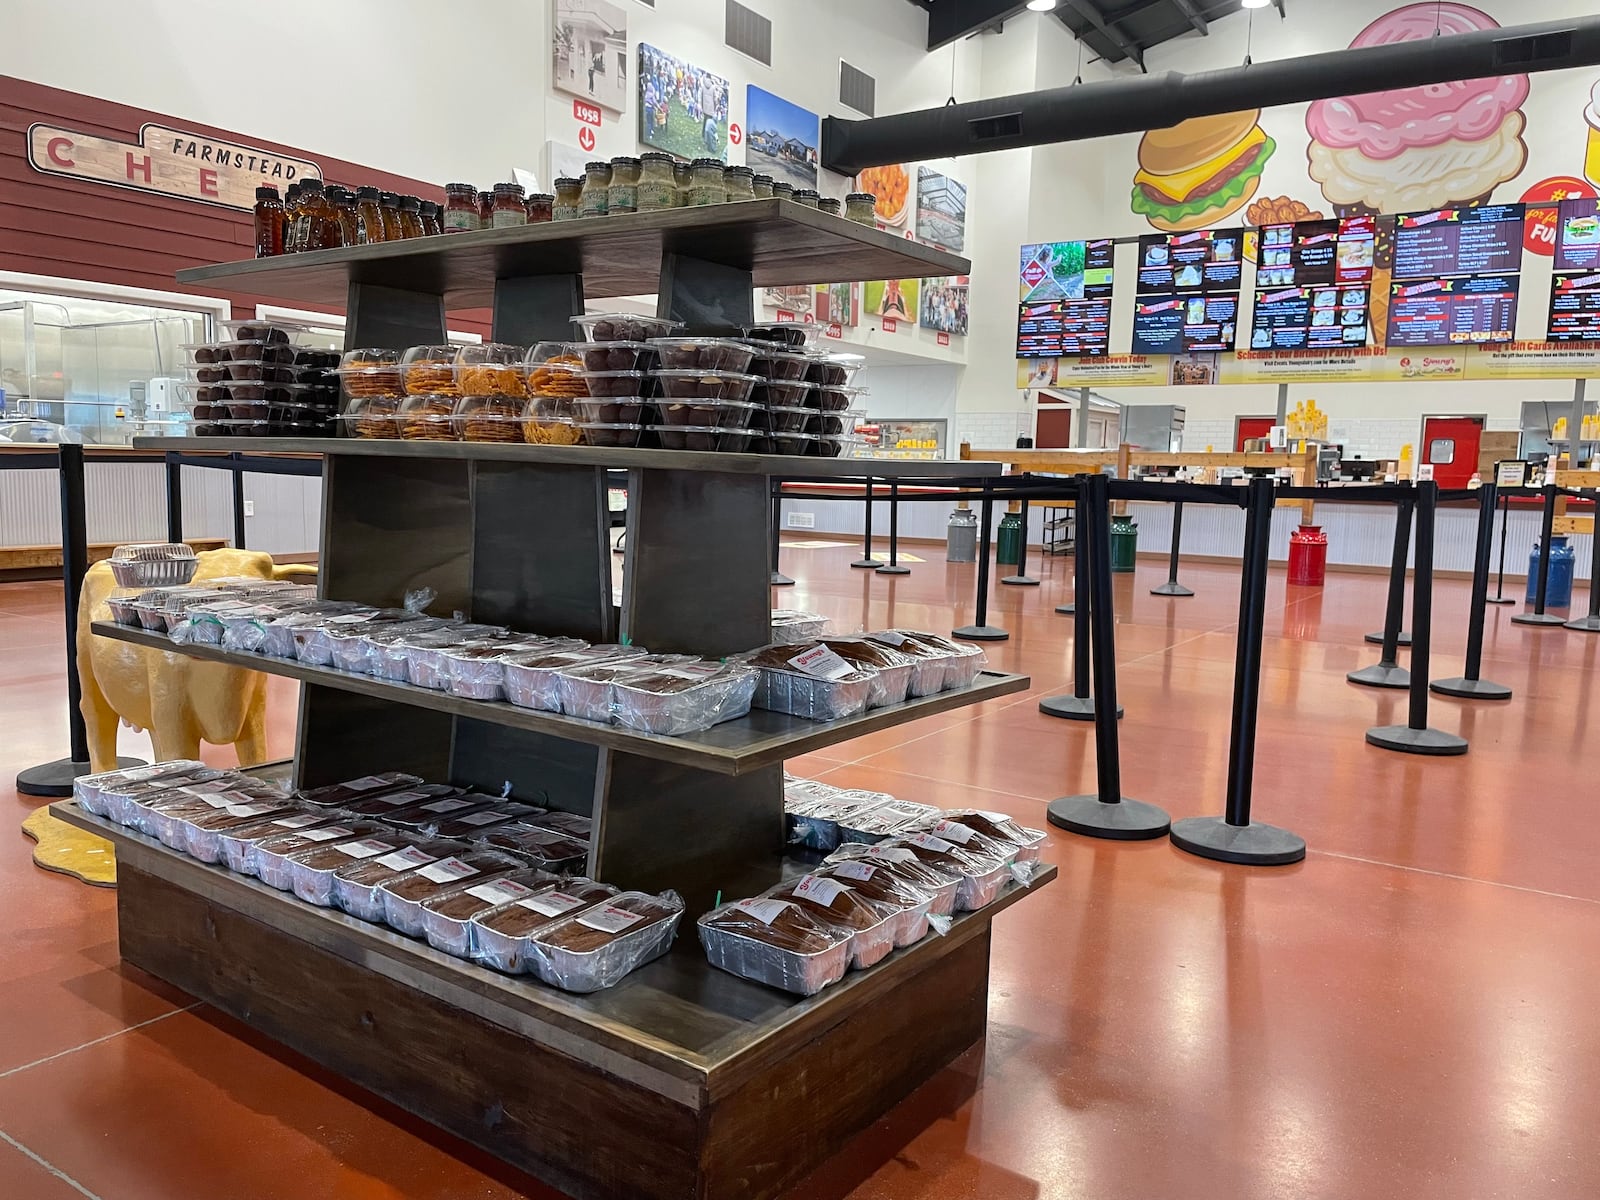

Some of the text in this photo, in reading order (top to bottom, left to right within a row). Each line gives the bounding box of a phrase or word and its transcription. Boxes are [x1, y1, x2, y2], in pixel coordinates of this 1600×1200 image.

[577, 106, 599, 123] 1958
[172, 138, 296, 180] FARMSTEAD
[1525, 209, 1544, 220] for
[1542, 211, 1558, 225] fa
[1237, 345, 1387, 360] Schedule Your Birthday Party with Us!
[797, 649, 825, 665] Young's
